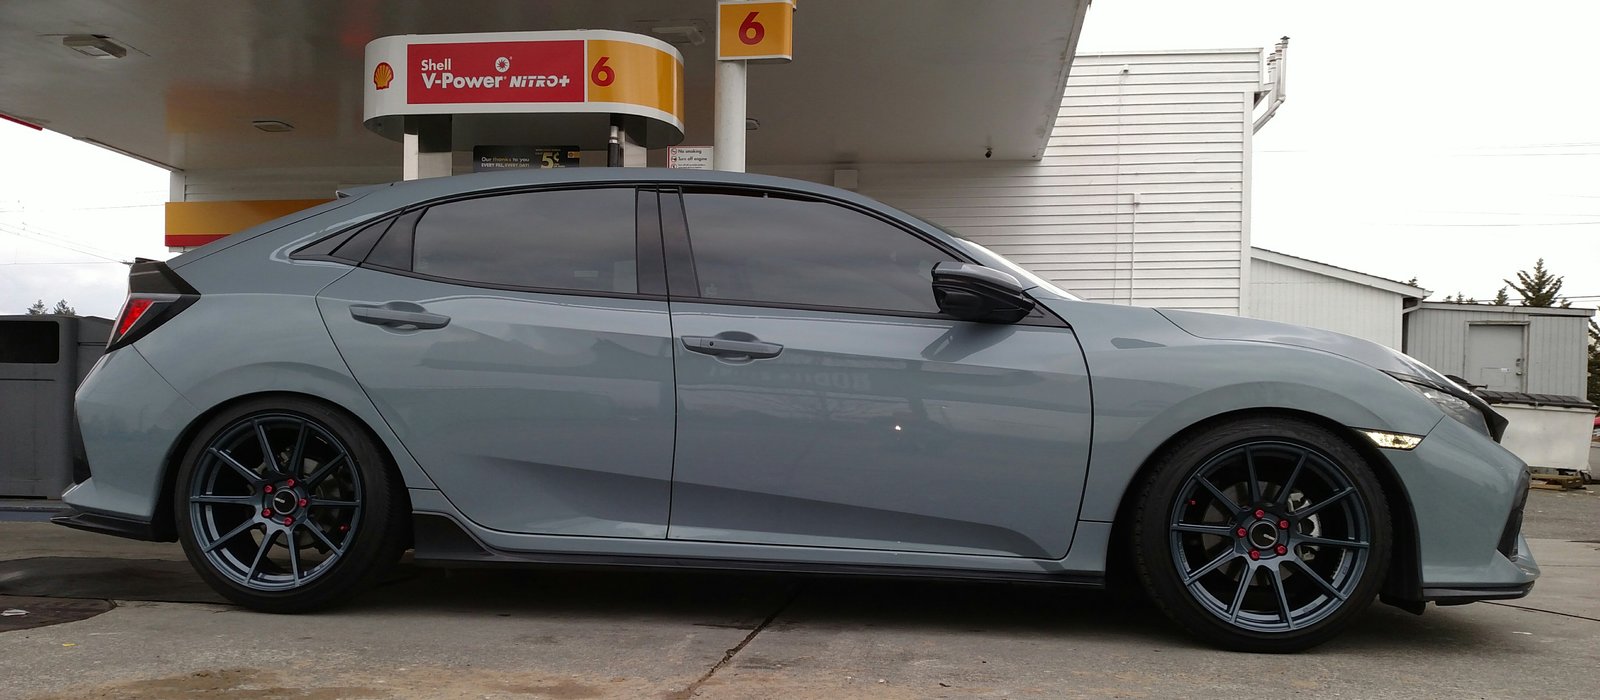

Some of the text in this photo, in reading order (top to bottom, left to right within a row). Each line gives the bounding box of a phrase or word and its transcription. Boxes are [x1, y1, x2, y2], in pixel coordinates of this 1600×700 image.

[738, 11, 765, 45] 6
[421, 58, 451, 71] Shell
[591, 56, 615, 87] 6
[421, 72, 504, 89] V-Power
